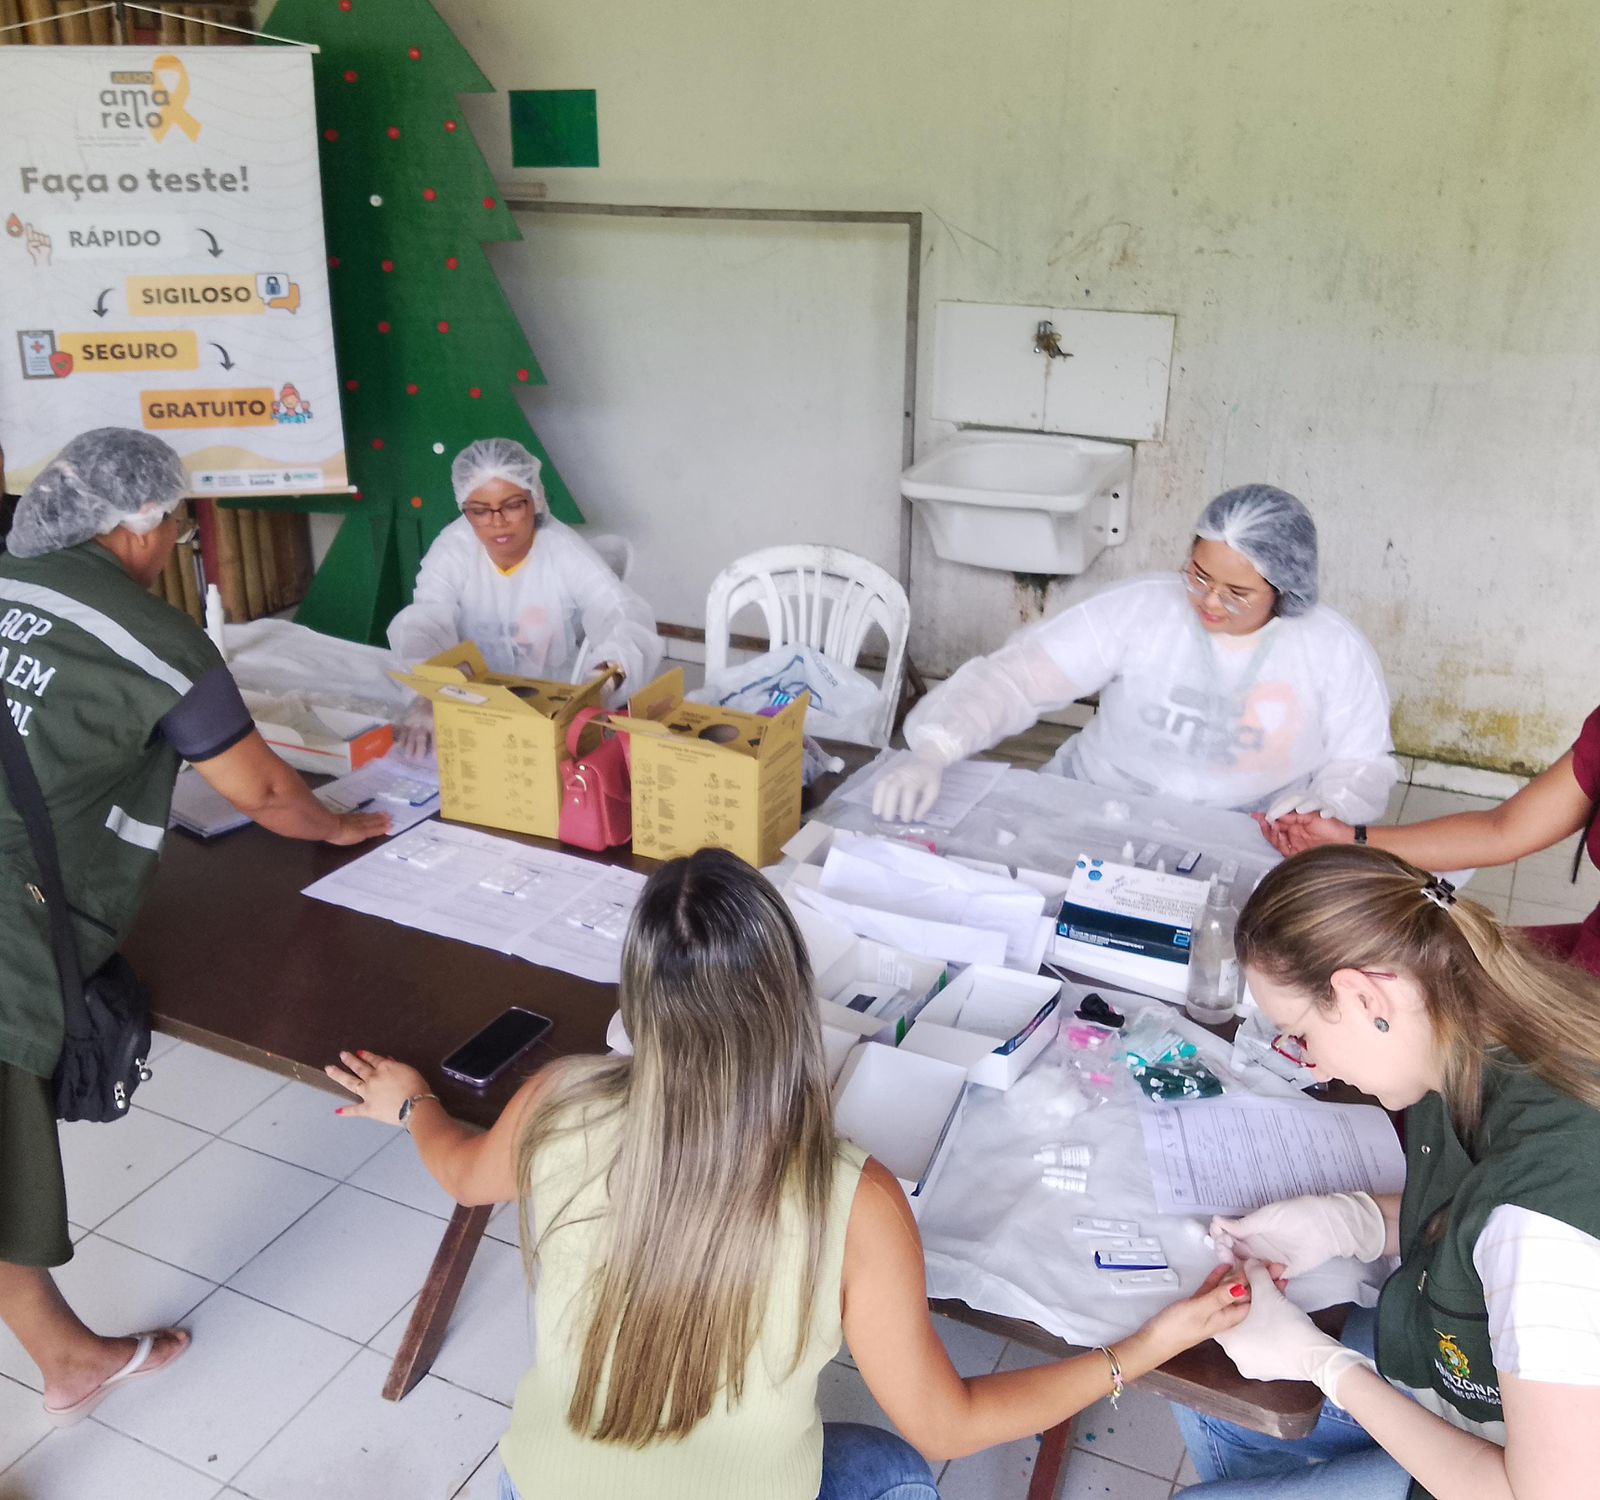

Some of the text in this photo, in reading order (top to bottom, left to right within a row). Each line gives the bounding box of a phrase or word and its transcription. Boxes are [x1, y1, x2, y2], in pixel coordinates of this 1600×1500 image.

[100, 89, 170, 107] ama
[101, 111, 163, 129] relo
[20, 165, 249, 200] Faça o teste!
[69, 226, 161, 248] RÁPIDO
[142, 286, 251, 305] SIGILOSO
[82, 342, 178, 361] SEGURO
[148, 399, 266, 419] GRATUITO
[7, 654, 56, 697] EM
